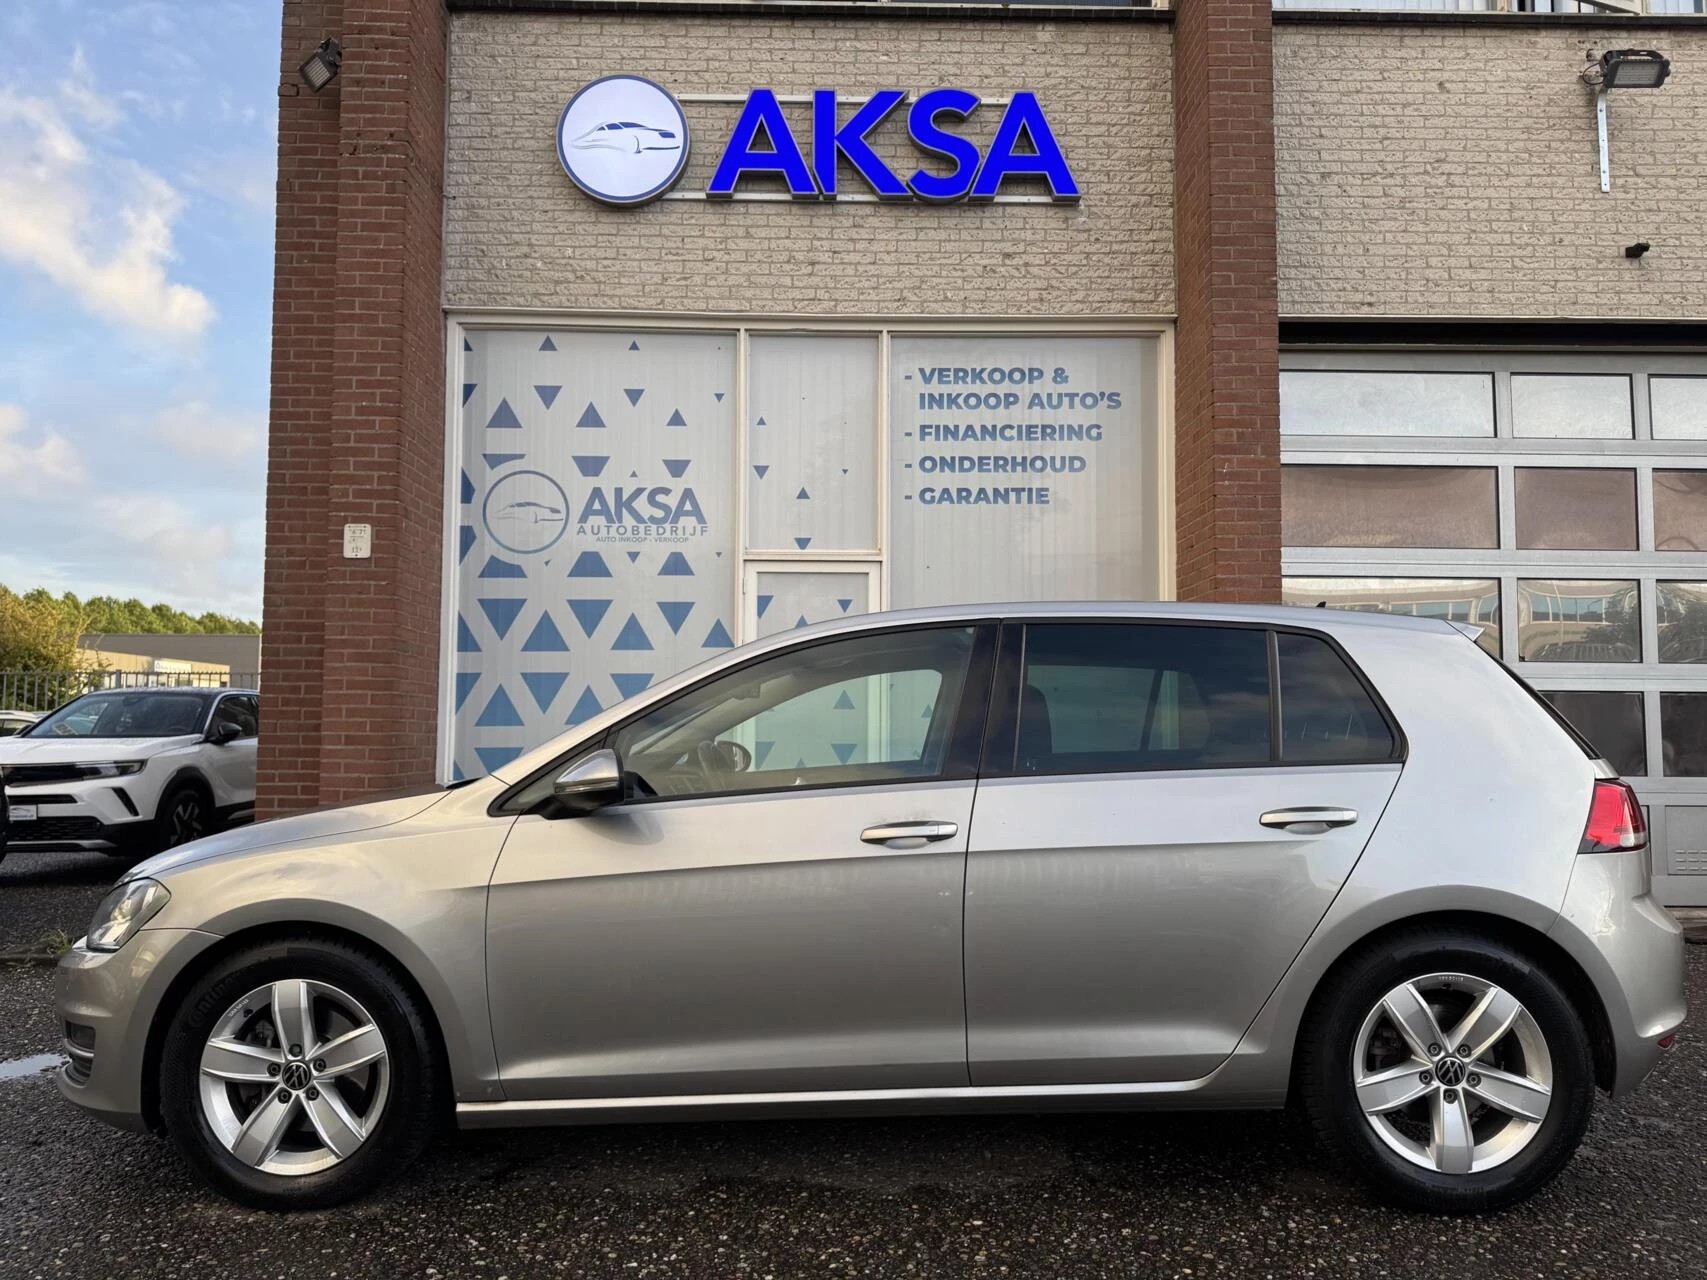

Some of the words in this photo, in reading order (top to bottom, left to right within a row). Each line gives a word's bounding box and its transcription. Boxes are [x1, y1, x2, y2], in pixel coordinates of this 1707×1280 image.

[706, 89, 1081, 203] AKSA
[918, 367, 1044, 385] VERKOOP
[1052, 367, 1069, 385] &
[919, 392, 1020, 410] INKOOP
[1027, 391, 1122, 410] AUTO’S
[919, 424, 1103, 442] FINANCIERING
[918, 456, 1087, 474] ONDERHOUD
[918, 487, 1050, 505] GARANTIE
[577, 486, 707, 525] AKSA
[576, 525, 708, 537] AUTOBEDRIJF
